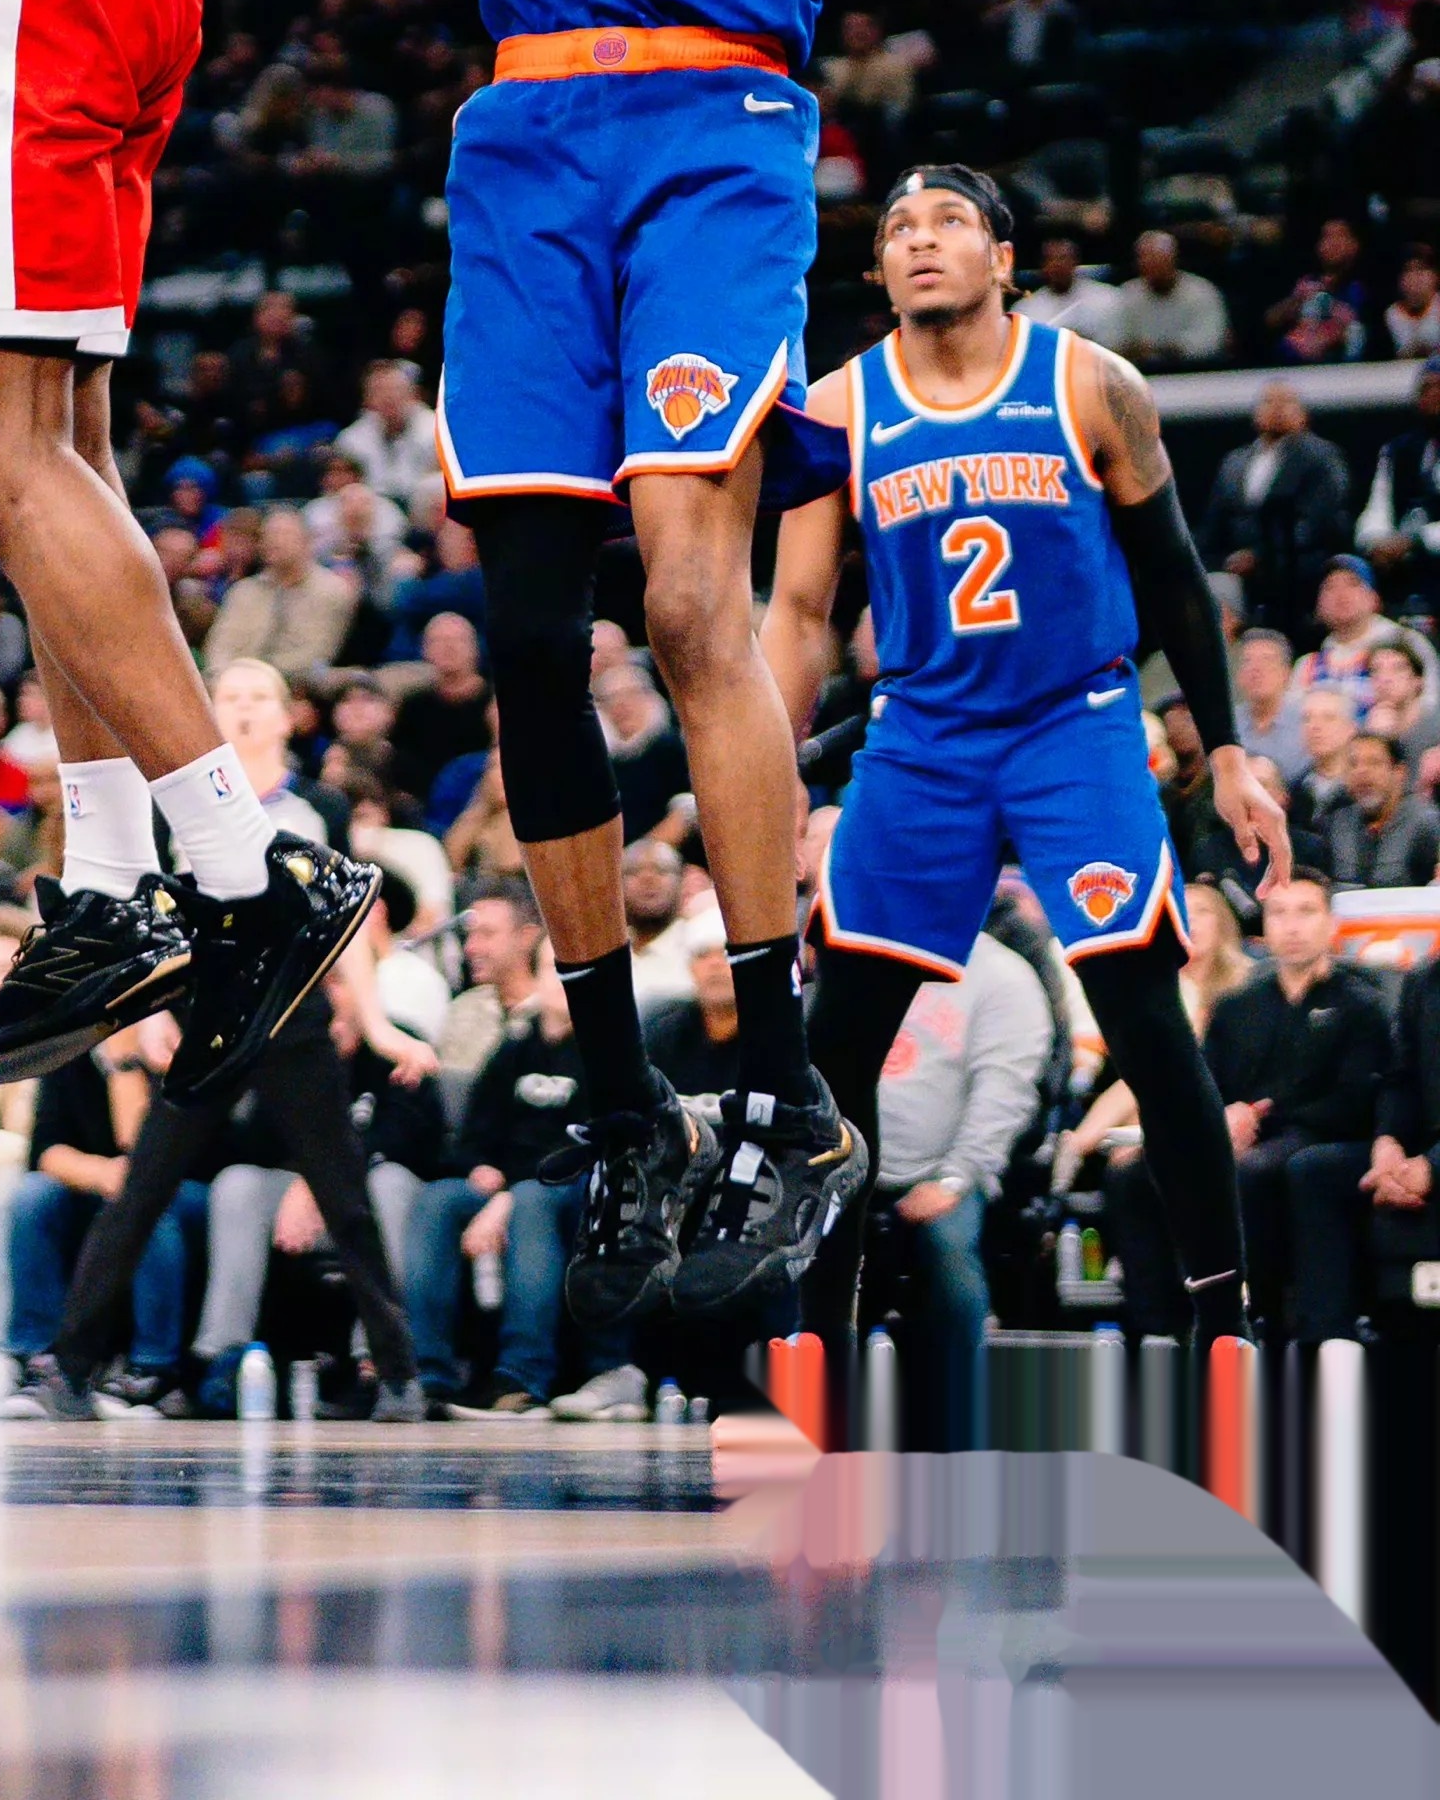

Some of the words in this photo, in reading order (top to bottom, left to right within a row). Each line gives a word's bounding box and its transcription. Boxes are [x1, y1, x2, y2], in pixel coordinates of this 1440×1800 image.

[868, 456, 954, 530] NEW
[954, 451, 1070, 507] YORK
[941, 515, 1021, 634] 2
